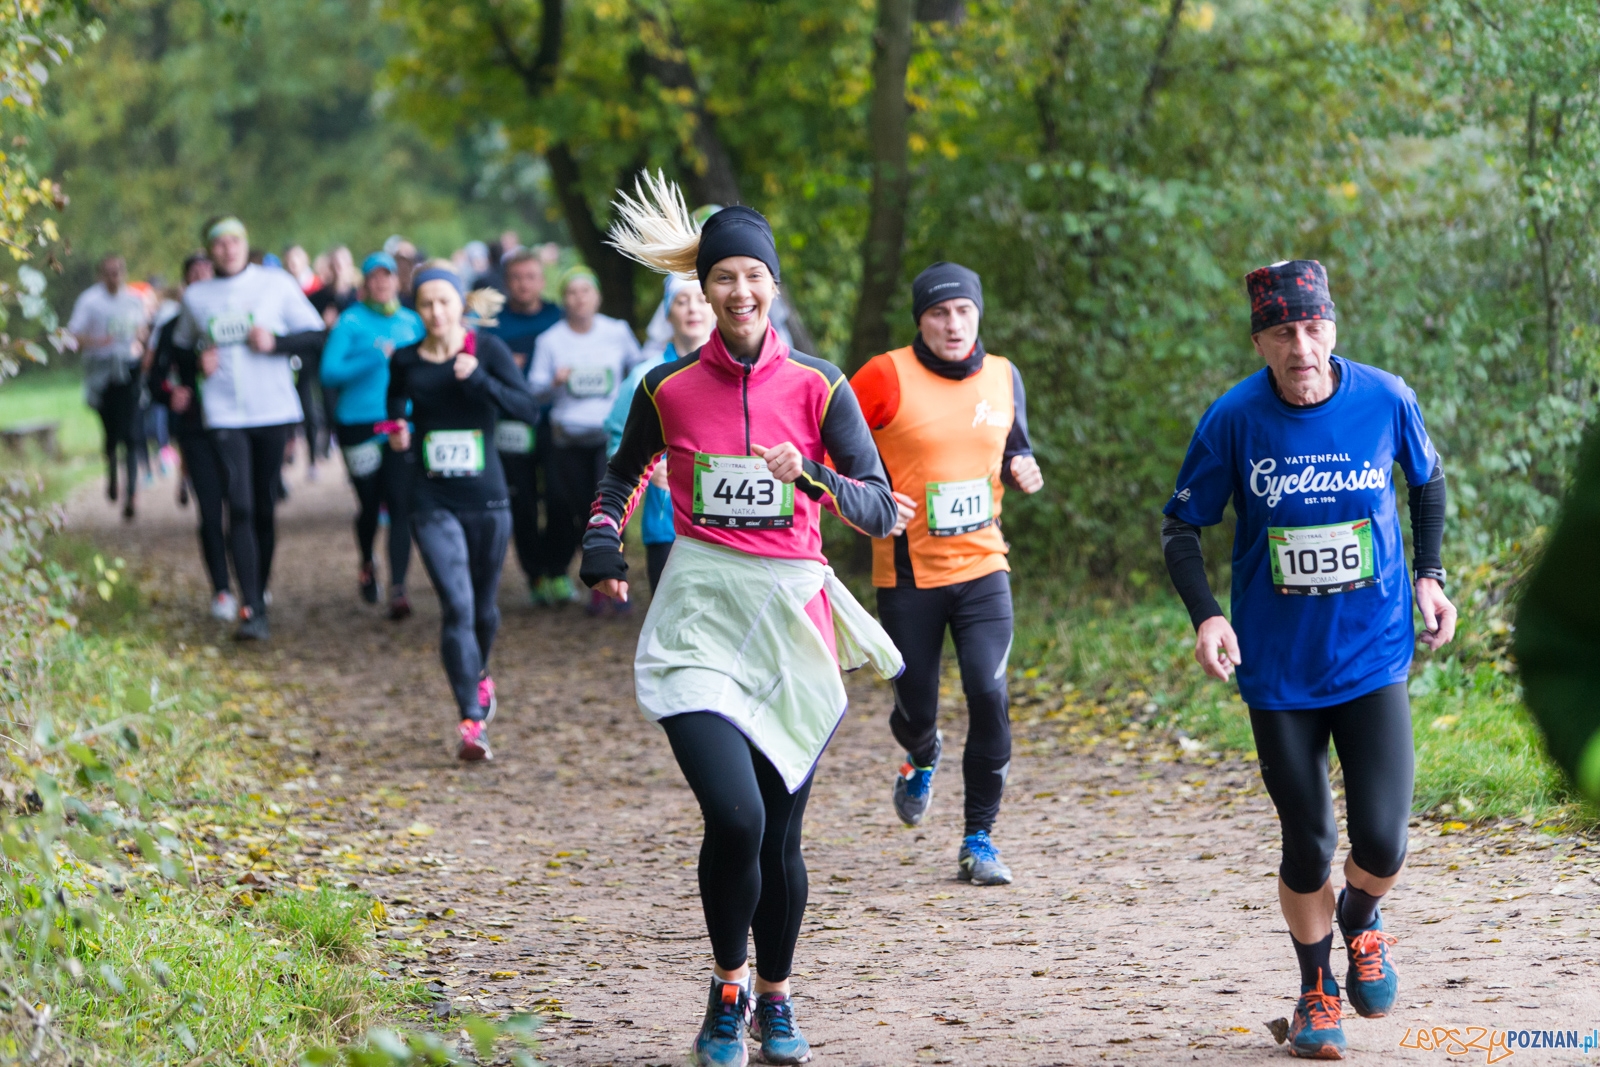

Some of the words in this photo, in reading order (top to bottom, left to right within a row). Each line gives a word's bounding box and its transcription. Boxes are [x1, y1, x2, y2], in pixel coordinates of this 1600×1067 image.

[435, 444, 469, 463] 673
[1284, 452, 1351, 465] VATTENFALL
[713, 478, 774, 505] 443
[1249, 457, 1386, 508] Cyclassics
[950, 494, 980, 517] 411
[1304, 497, 1320, 505] EST.
[1320, 496, 1336, 504] 1996
[1284, 544, 1359, 575] 1036
[1310, 576, 1338, 584] ROMAN
